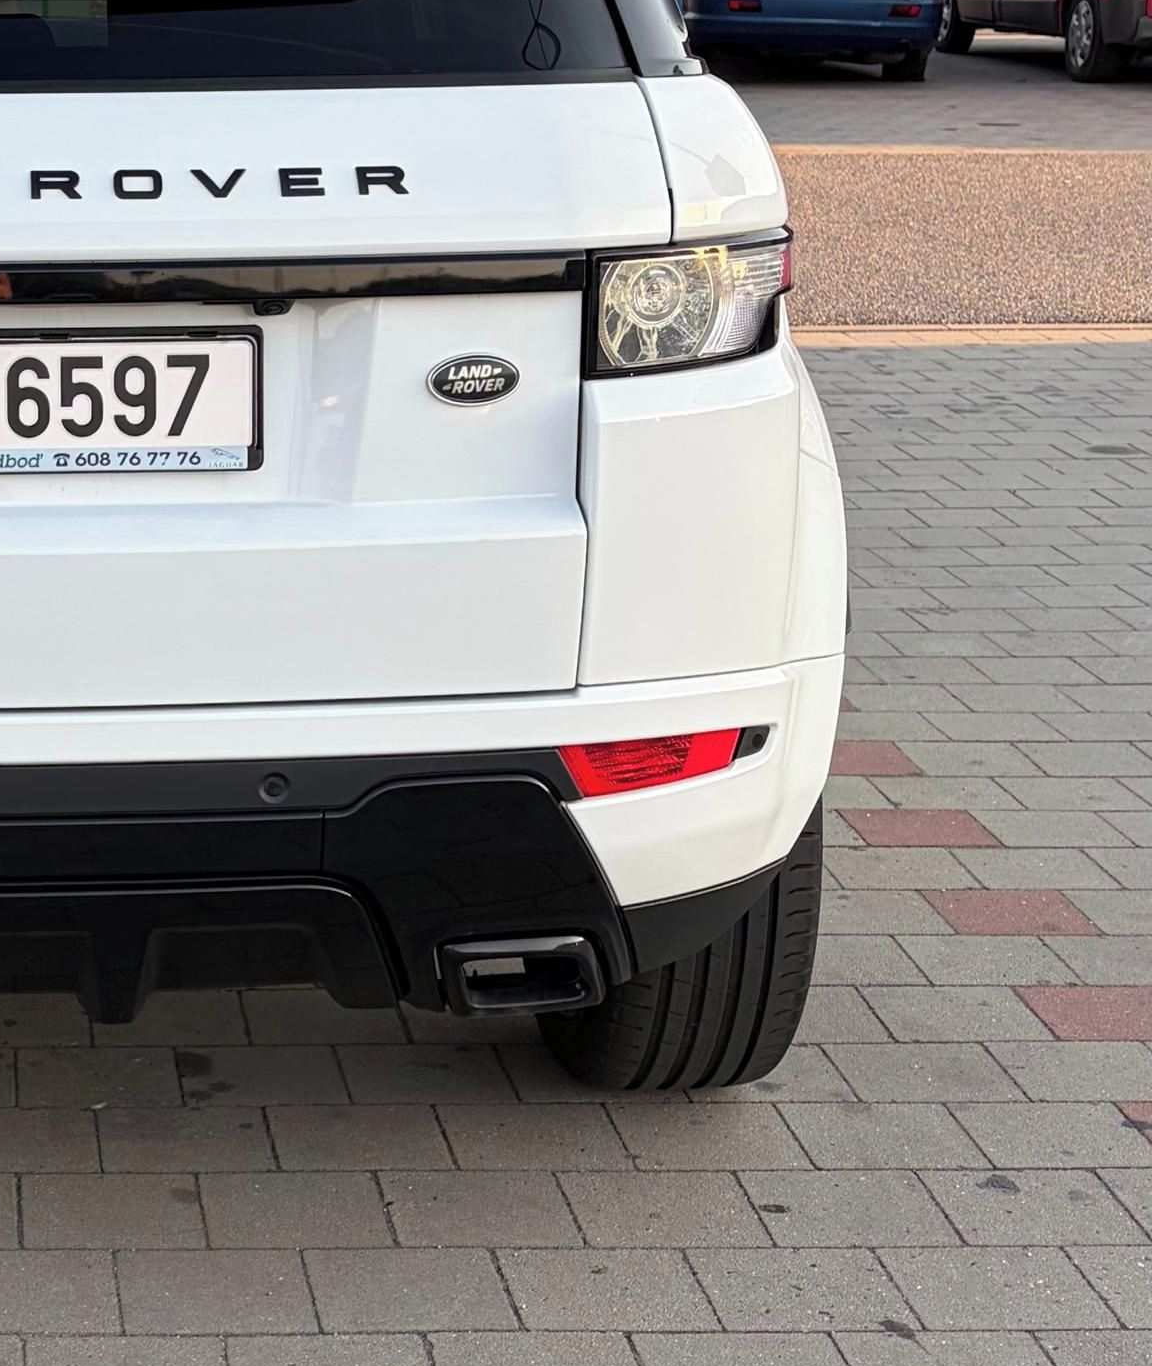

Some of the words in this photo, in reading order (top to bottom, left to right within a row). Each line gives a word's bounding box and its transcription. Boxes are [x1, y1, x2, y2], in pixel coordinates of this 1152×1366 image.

[29, 164, 410, 202] ROVER
[448, 364, 493, 381] LAND
[451, 377, 506, 395] ROVER
[5, 353, 211, 439] 6597
[74, 451, 112, 467] 608
[117, 451, 142, 467] 76
[147, 451, 171, 467] 77
[177, 450, 202, 466] 76
